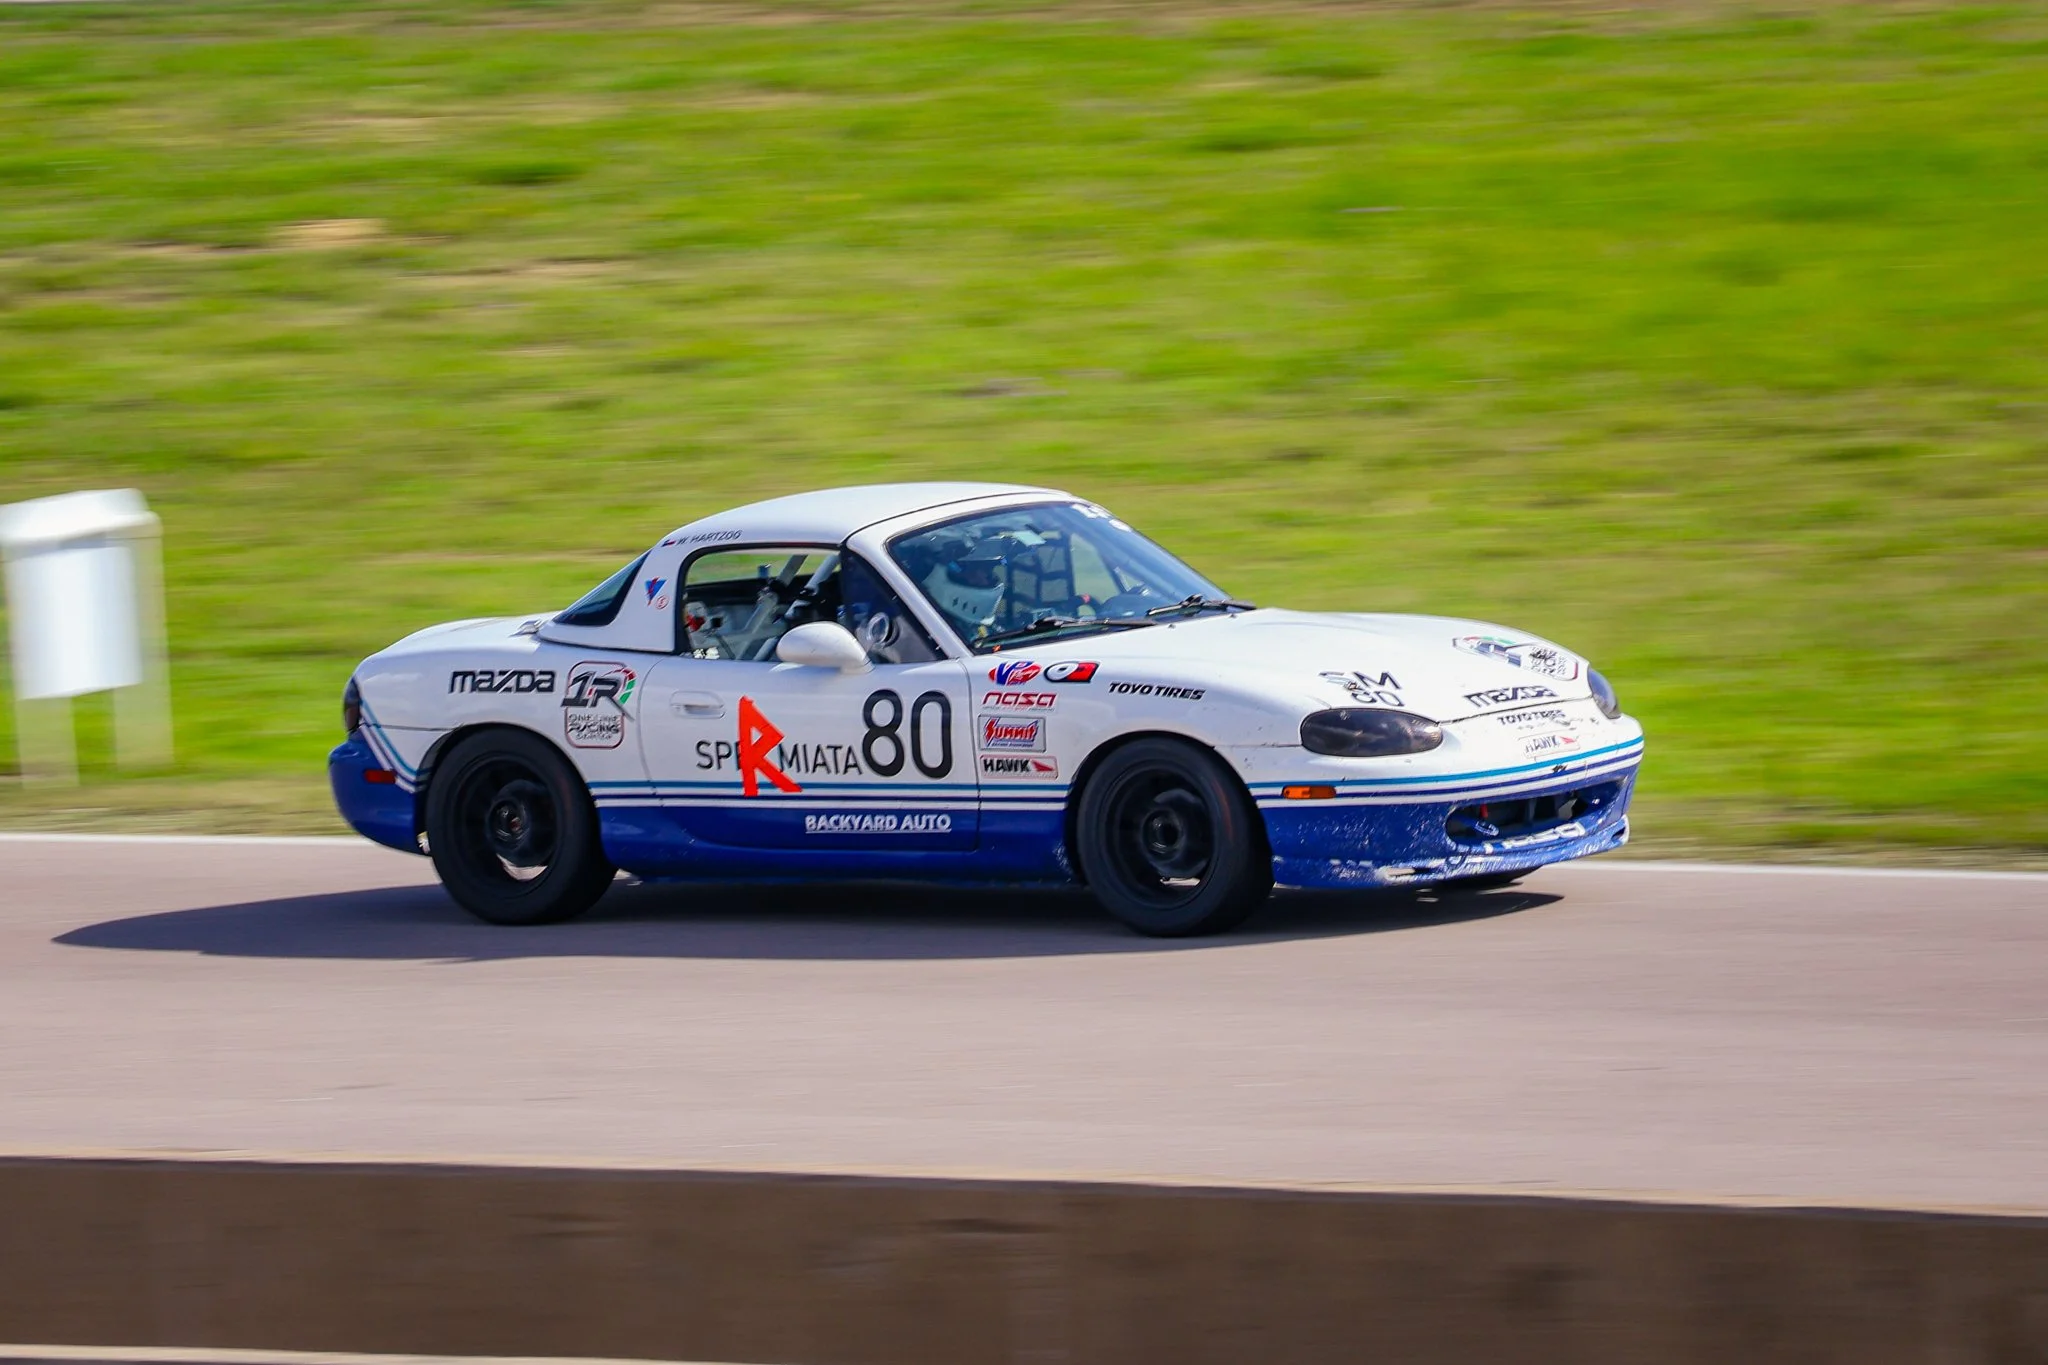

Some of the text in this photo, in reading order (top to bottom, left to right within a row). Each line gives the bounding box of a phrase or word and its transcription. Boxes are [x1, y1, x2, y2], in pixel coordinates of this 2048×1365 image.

[1109, 682, 1207, 701] TOYO TIRES
[862, 688, 953, 779] 80
[778, 743, 863, 776] MIATA
[983, 758, 1032, 773] HAWK
[805, 813, 952, 831] BACKYARD AUTO
